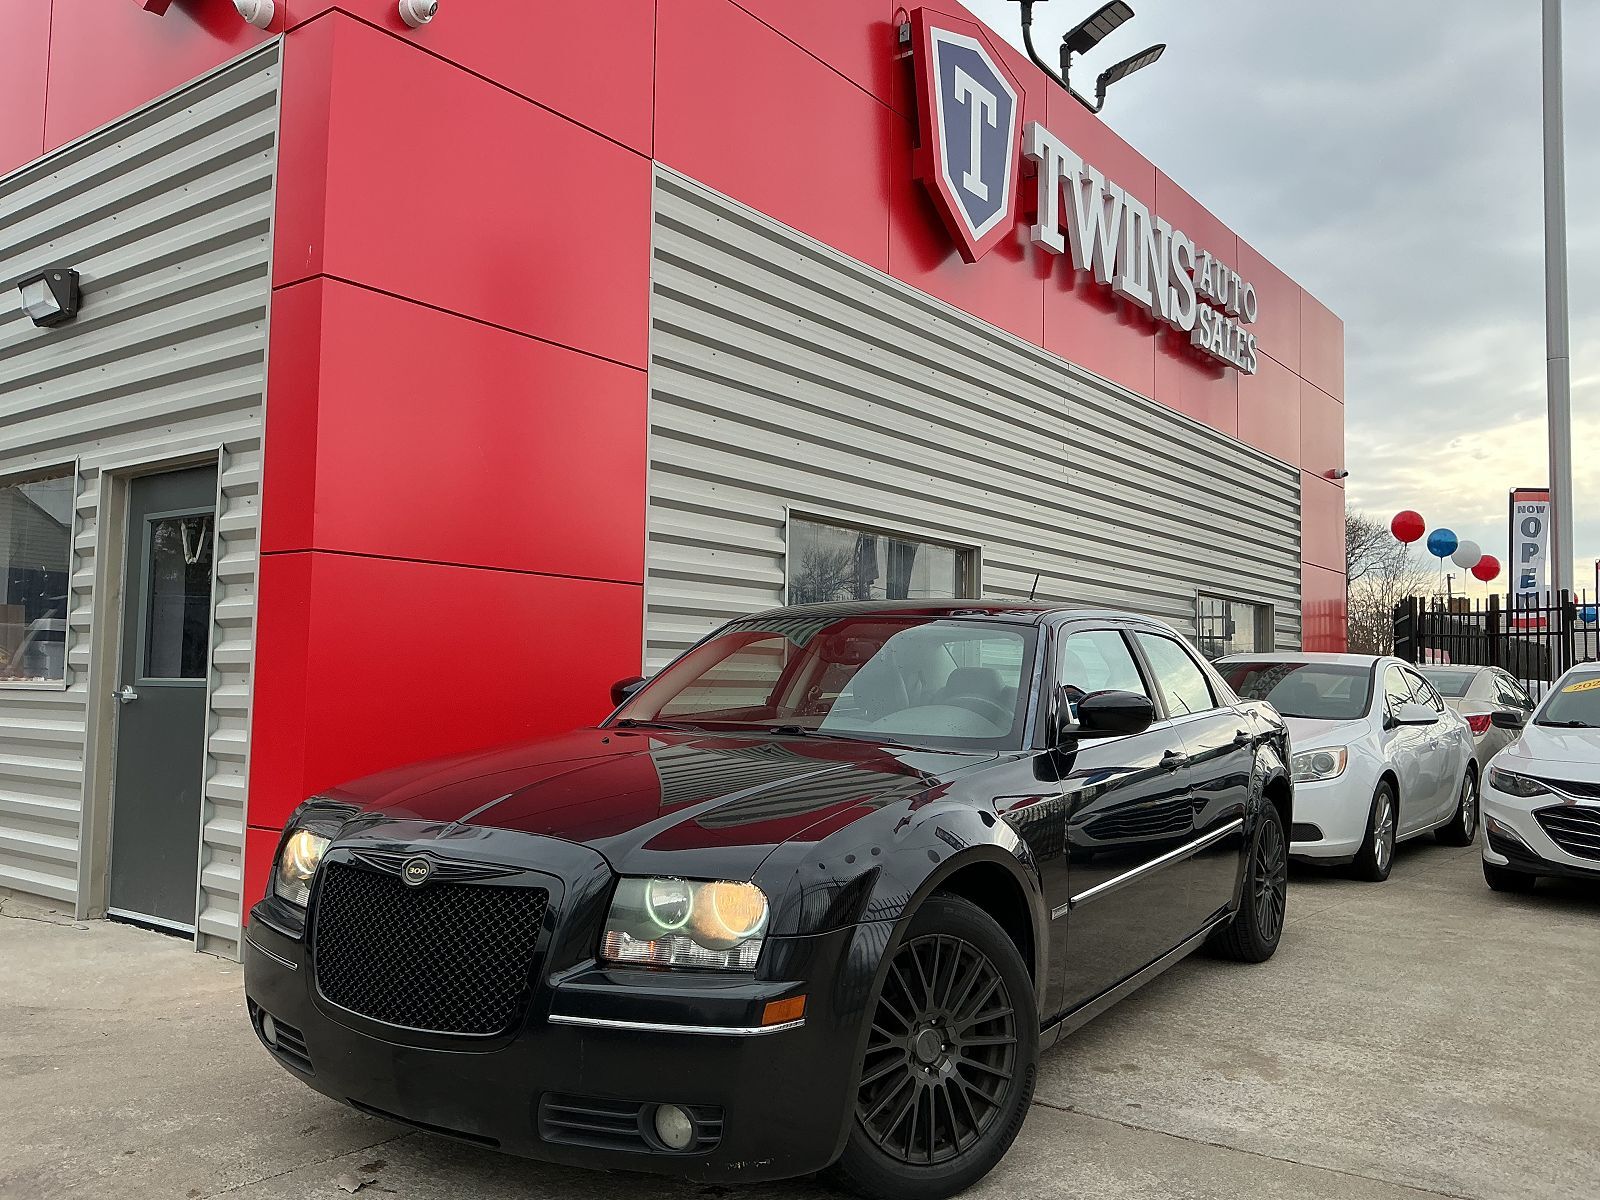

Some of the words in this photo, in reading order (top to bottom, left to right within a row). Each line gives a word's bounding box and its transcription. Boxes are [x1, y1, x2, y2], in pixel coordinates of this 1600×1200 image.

[954, 65, 997, 202] T
[1025, 121, 1197, 331] TWINS
[1198, 249, 1257, 323] AUTO
[1199, 302, 1256, 375] SALES
[1517, 505, 1545, 514] NOW
[409, 867, 427, 875] 300
